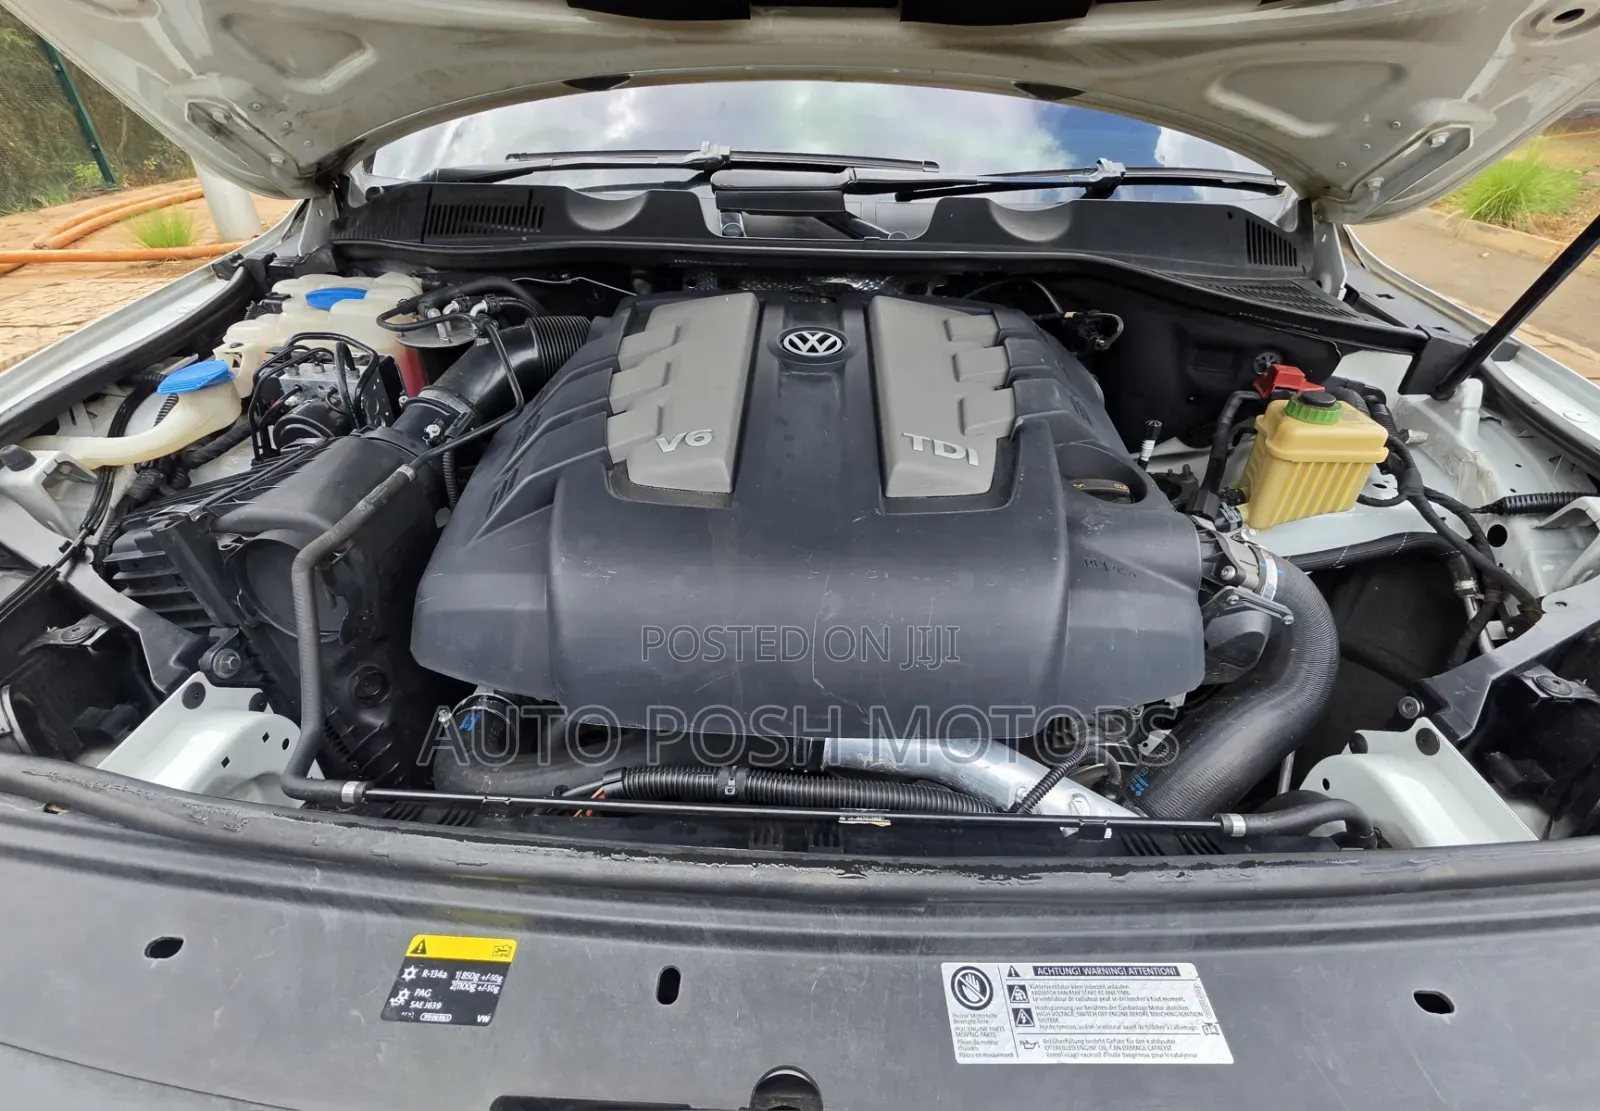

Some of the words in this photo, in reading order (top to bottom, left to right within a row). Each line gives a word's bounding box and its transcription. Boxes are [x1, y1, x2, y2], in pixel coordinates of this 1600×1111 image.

[656, 429, 713, 453] V6
[902, 432, 979, 467] TDI
[421, 968, 448, 979] R-134a
[1037, 966, 1081, 976] ACHTUNG!
[1082, 966, 1127, 976] WARNING!
[1128, 966, 1177, 976] ATTENTION!
[414, 988, 432, 997] PAG
[409, 1001, 424, 1010] SAE
[477, 1014, 492, 1022] VW
